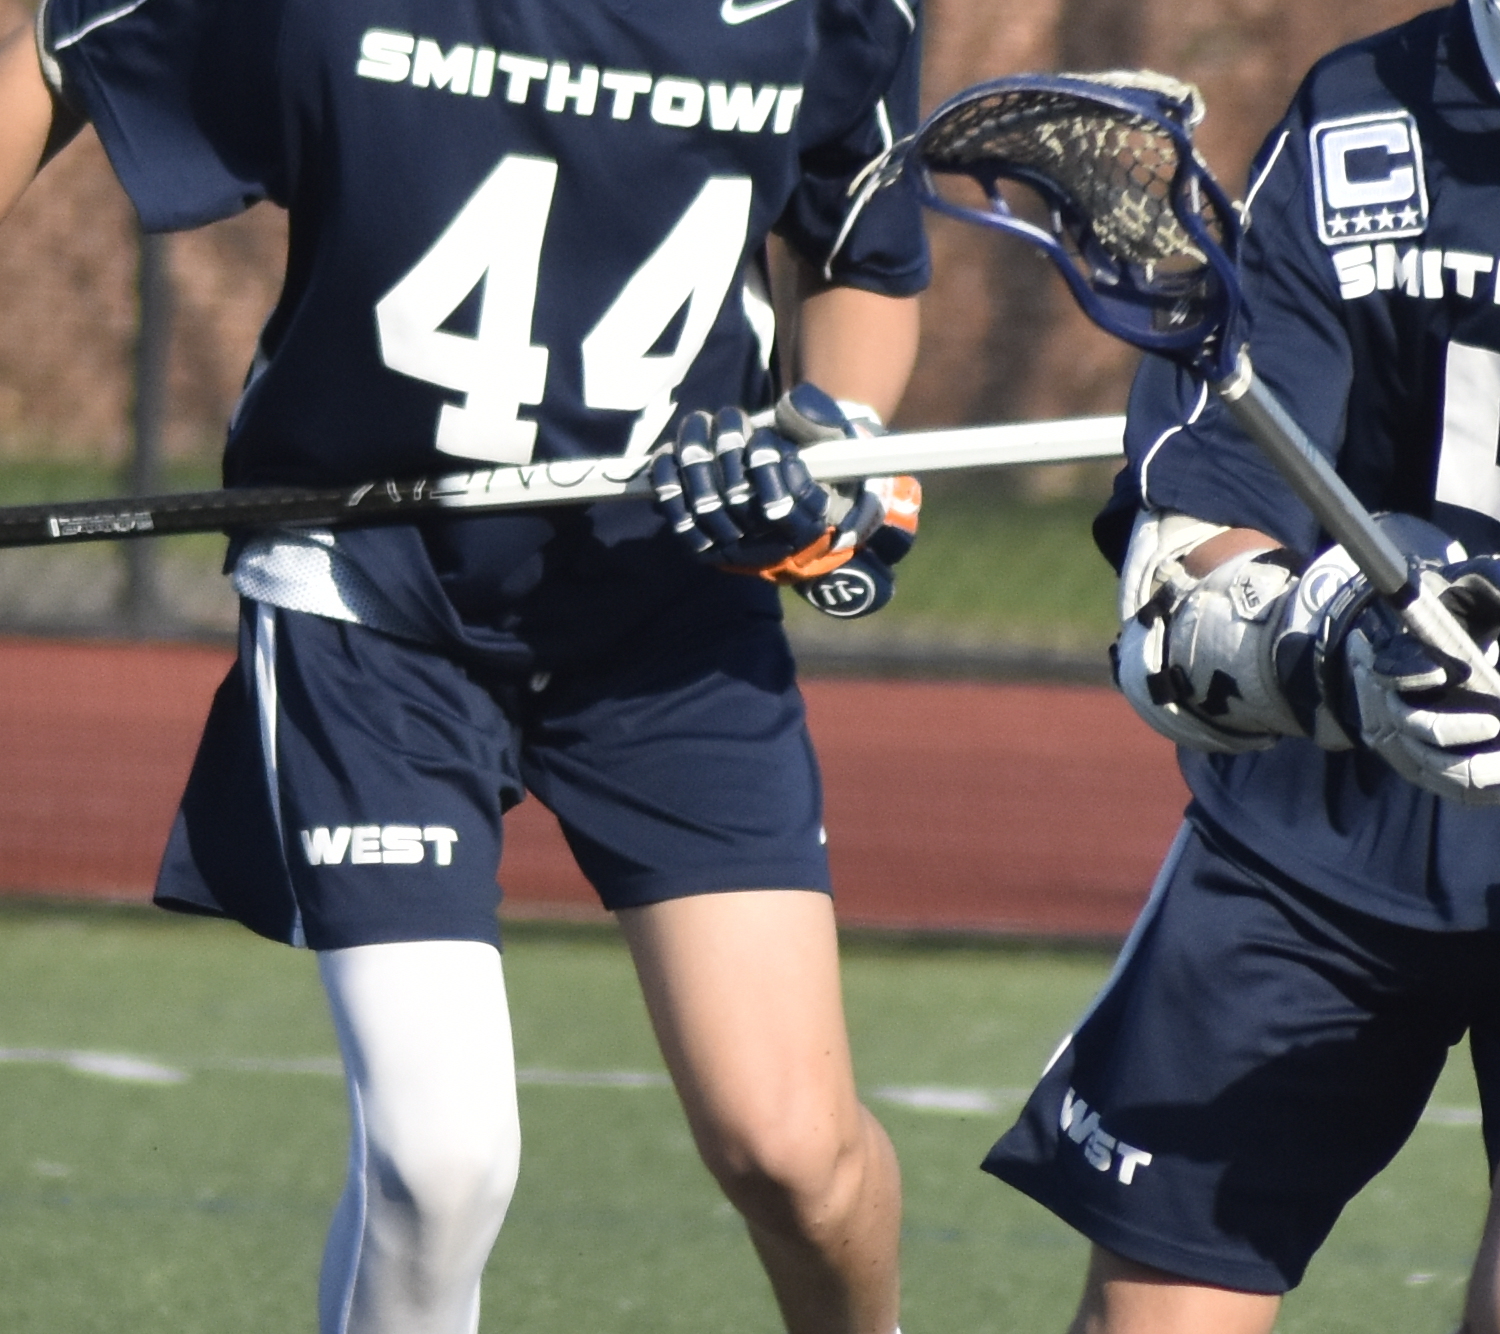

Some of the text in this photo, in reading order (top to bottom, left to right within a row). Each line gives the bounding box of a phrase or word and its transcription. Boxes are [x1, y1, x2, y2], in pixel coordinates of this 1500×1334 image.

[1321, 122, 1414, 210] C
[375, 152, 753, 466] 44
[300, 824, 459, 867] WEST
[1059, 1086, 1153, 1186] WST
